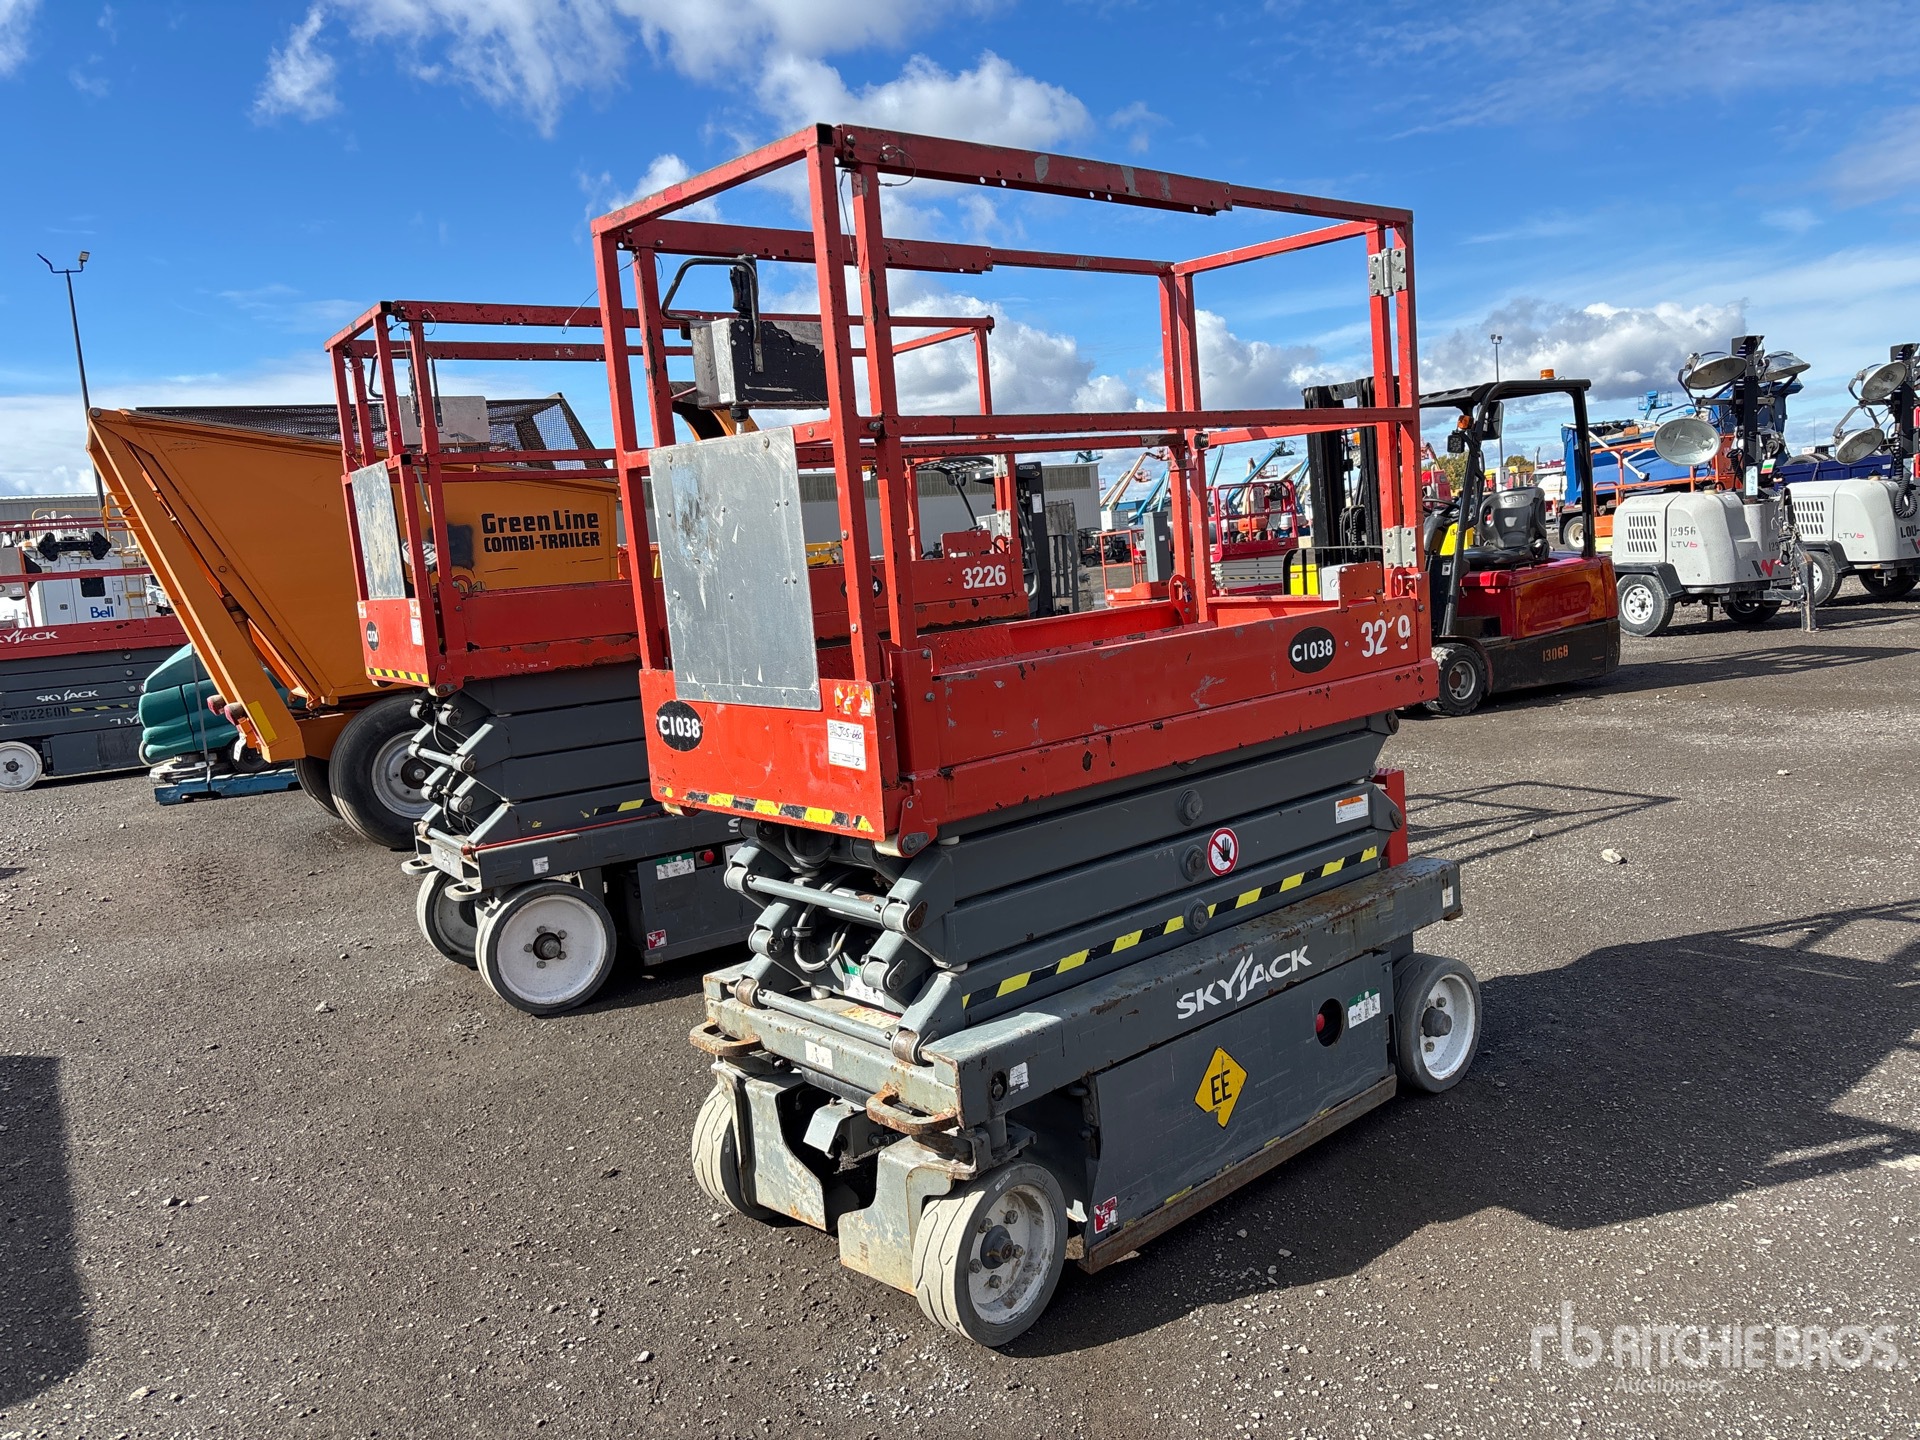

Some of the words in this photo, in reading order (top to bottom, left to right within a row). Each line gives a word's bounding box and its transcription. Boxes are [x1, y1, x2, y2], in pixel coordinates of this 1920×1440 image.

[481, 513, 550, 534] Green
[553, 510, 599, 531] Line
[484, 531, 600, 552] COMBI-TRAILER
[962, 564, 1007, 590] 3226
[90, 606, 114, 619] Bell
[1361, 615, 1411, 658] 329
[1291, 638, 1334, 663] C1038
[658, 715, 701, 739] C1038
[1176, 944, 1313, 1020] SKYJACK
